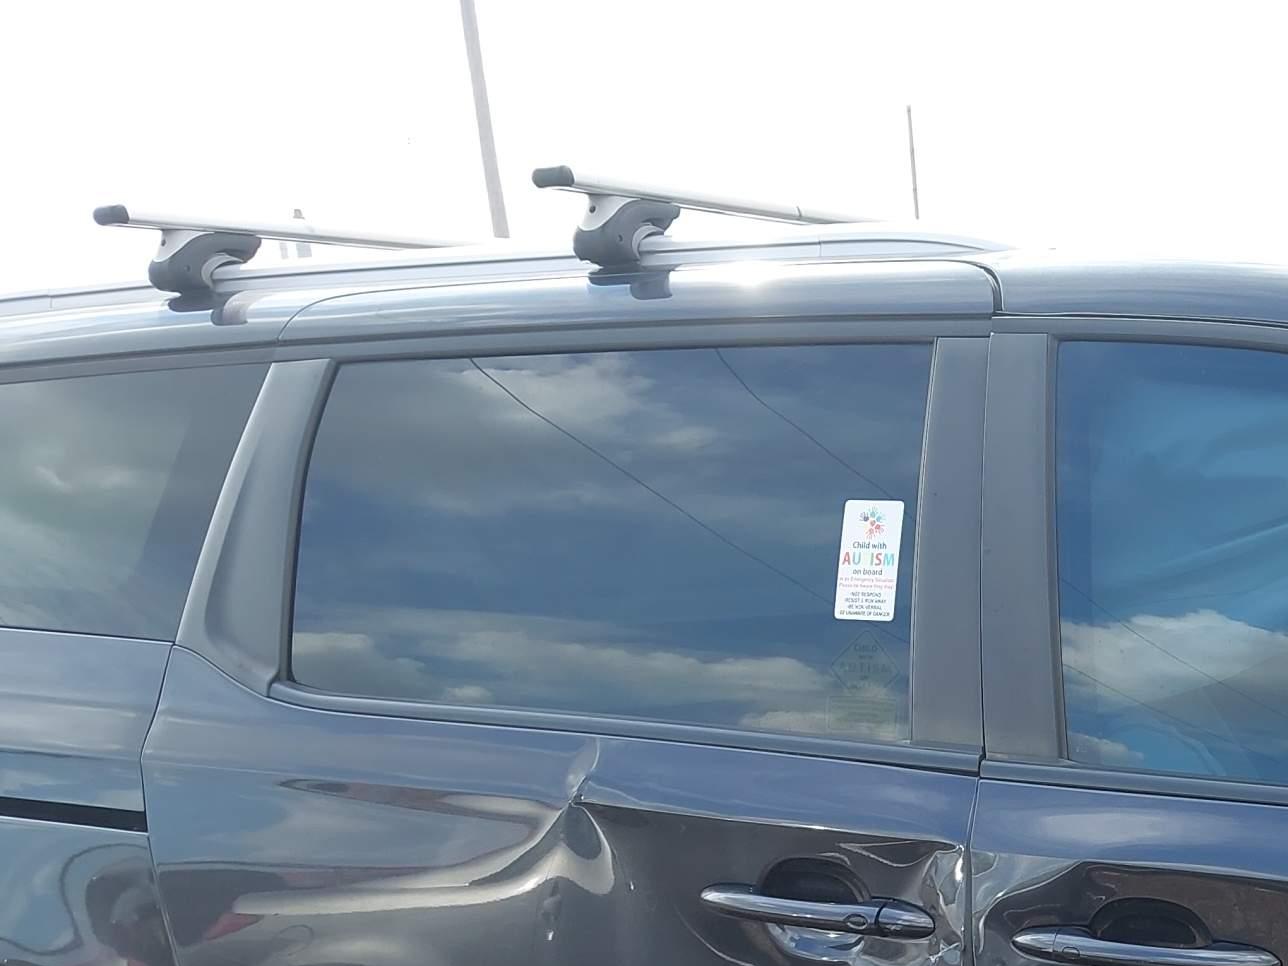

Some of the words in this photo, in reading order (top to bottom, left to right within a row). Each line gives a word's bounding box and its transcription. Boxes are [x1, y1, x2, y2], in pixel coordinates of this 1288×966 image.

[853, 541, 870, 549] Child
[842, 552, 895, 566] AUISM
[863, 568, 882, 576] board
